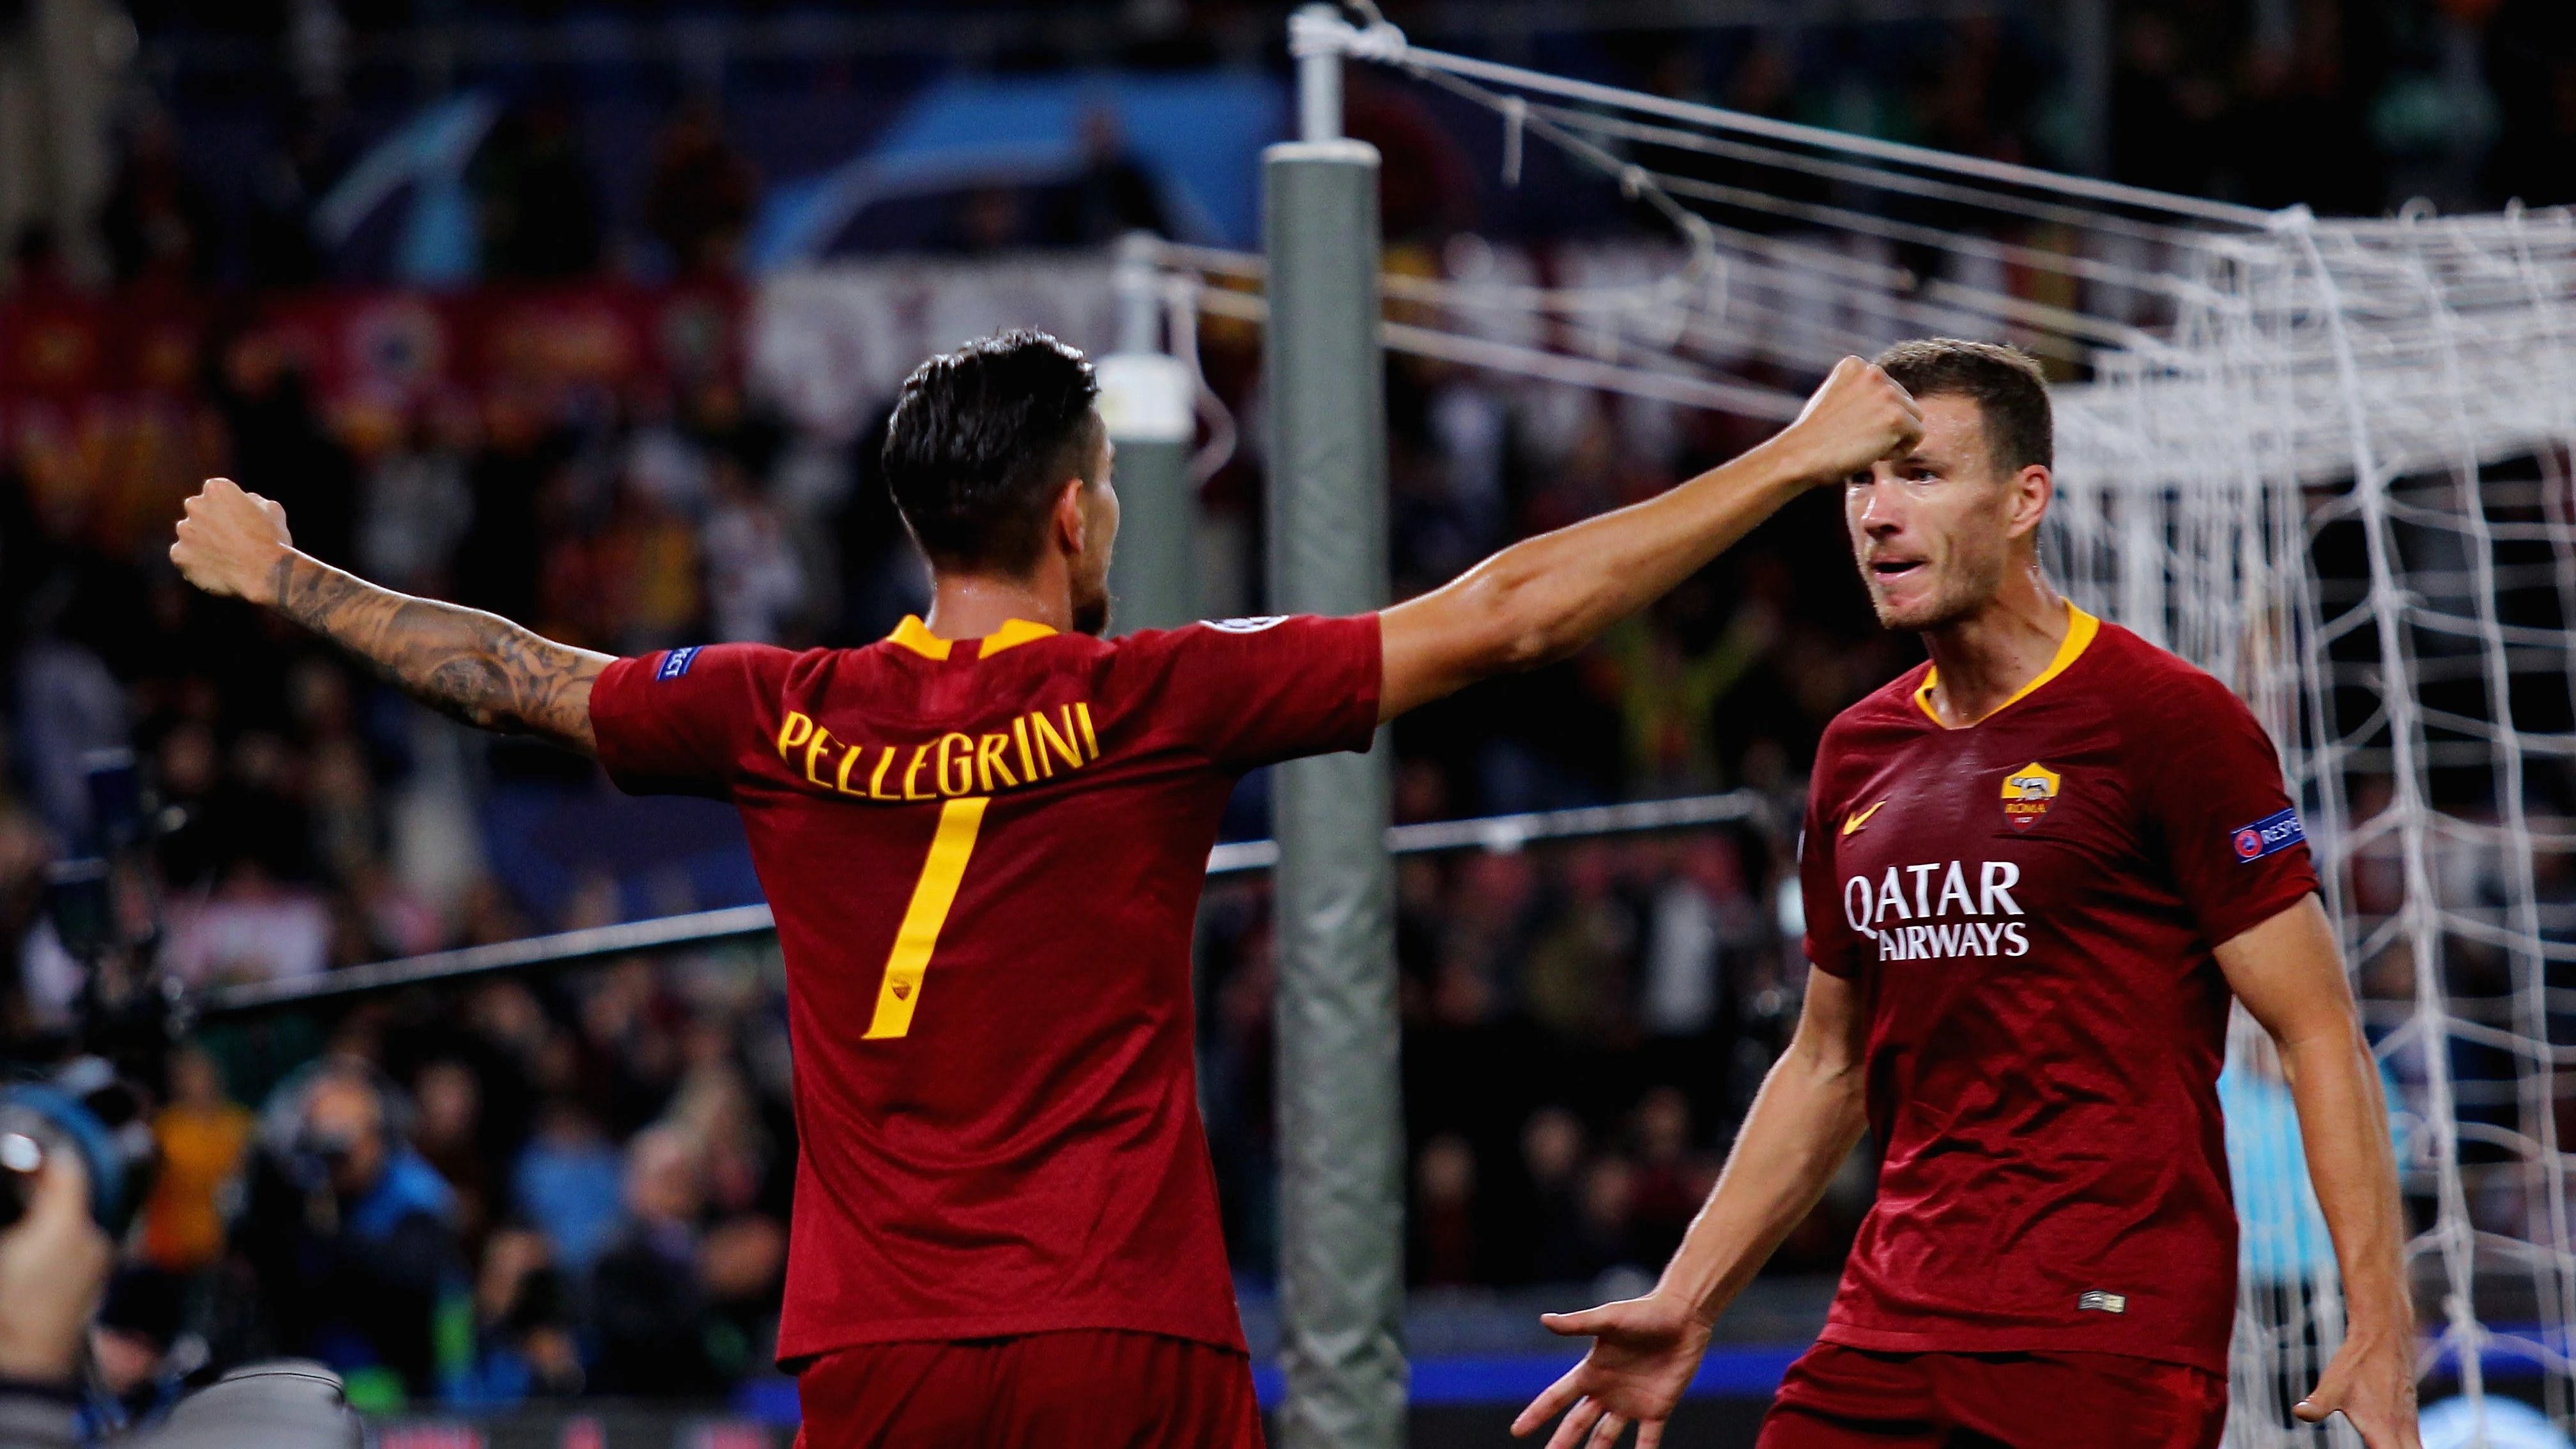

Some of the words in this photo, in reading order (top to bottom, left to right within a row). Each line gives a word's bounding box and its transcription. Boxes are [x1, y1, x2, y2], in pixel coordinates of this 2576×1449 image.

[777, 702, 1100, 801] PELLEGRINI
[2004, 802, 2047, 814] ROMA
[1844, 860, 2025, 940] QATAR
[1879, 921, 2030, 962] AIRWAYS
